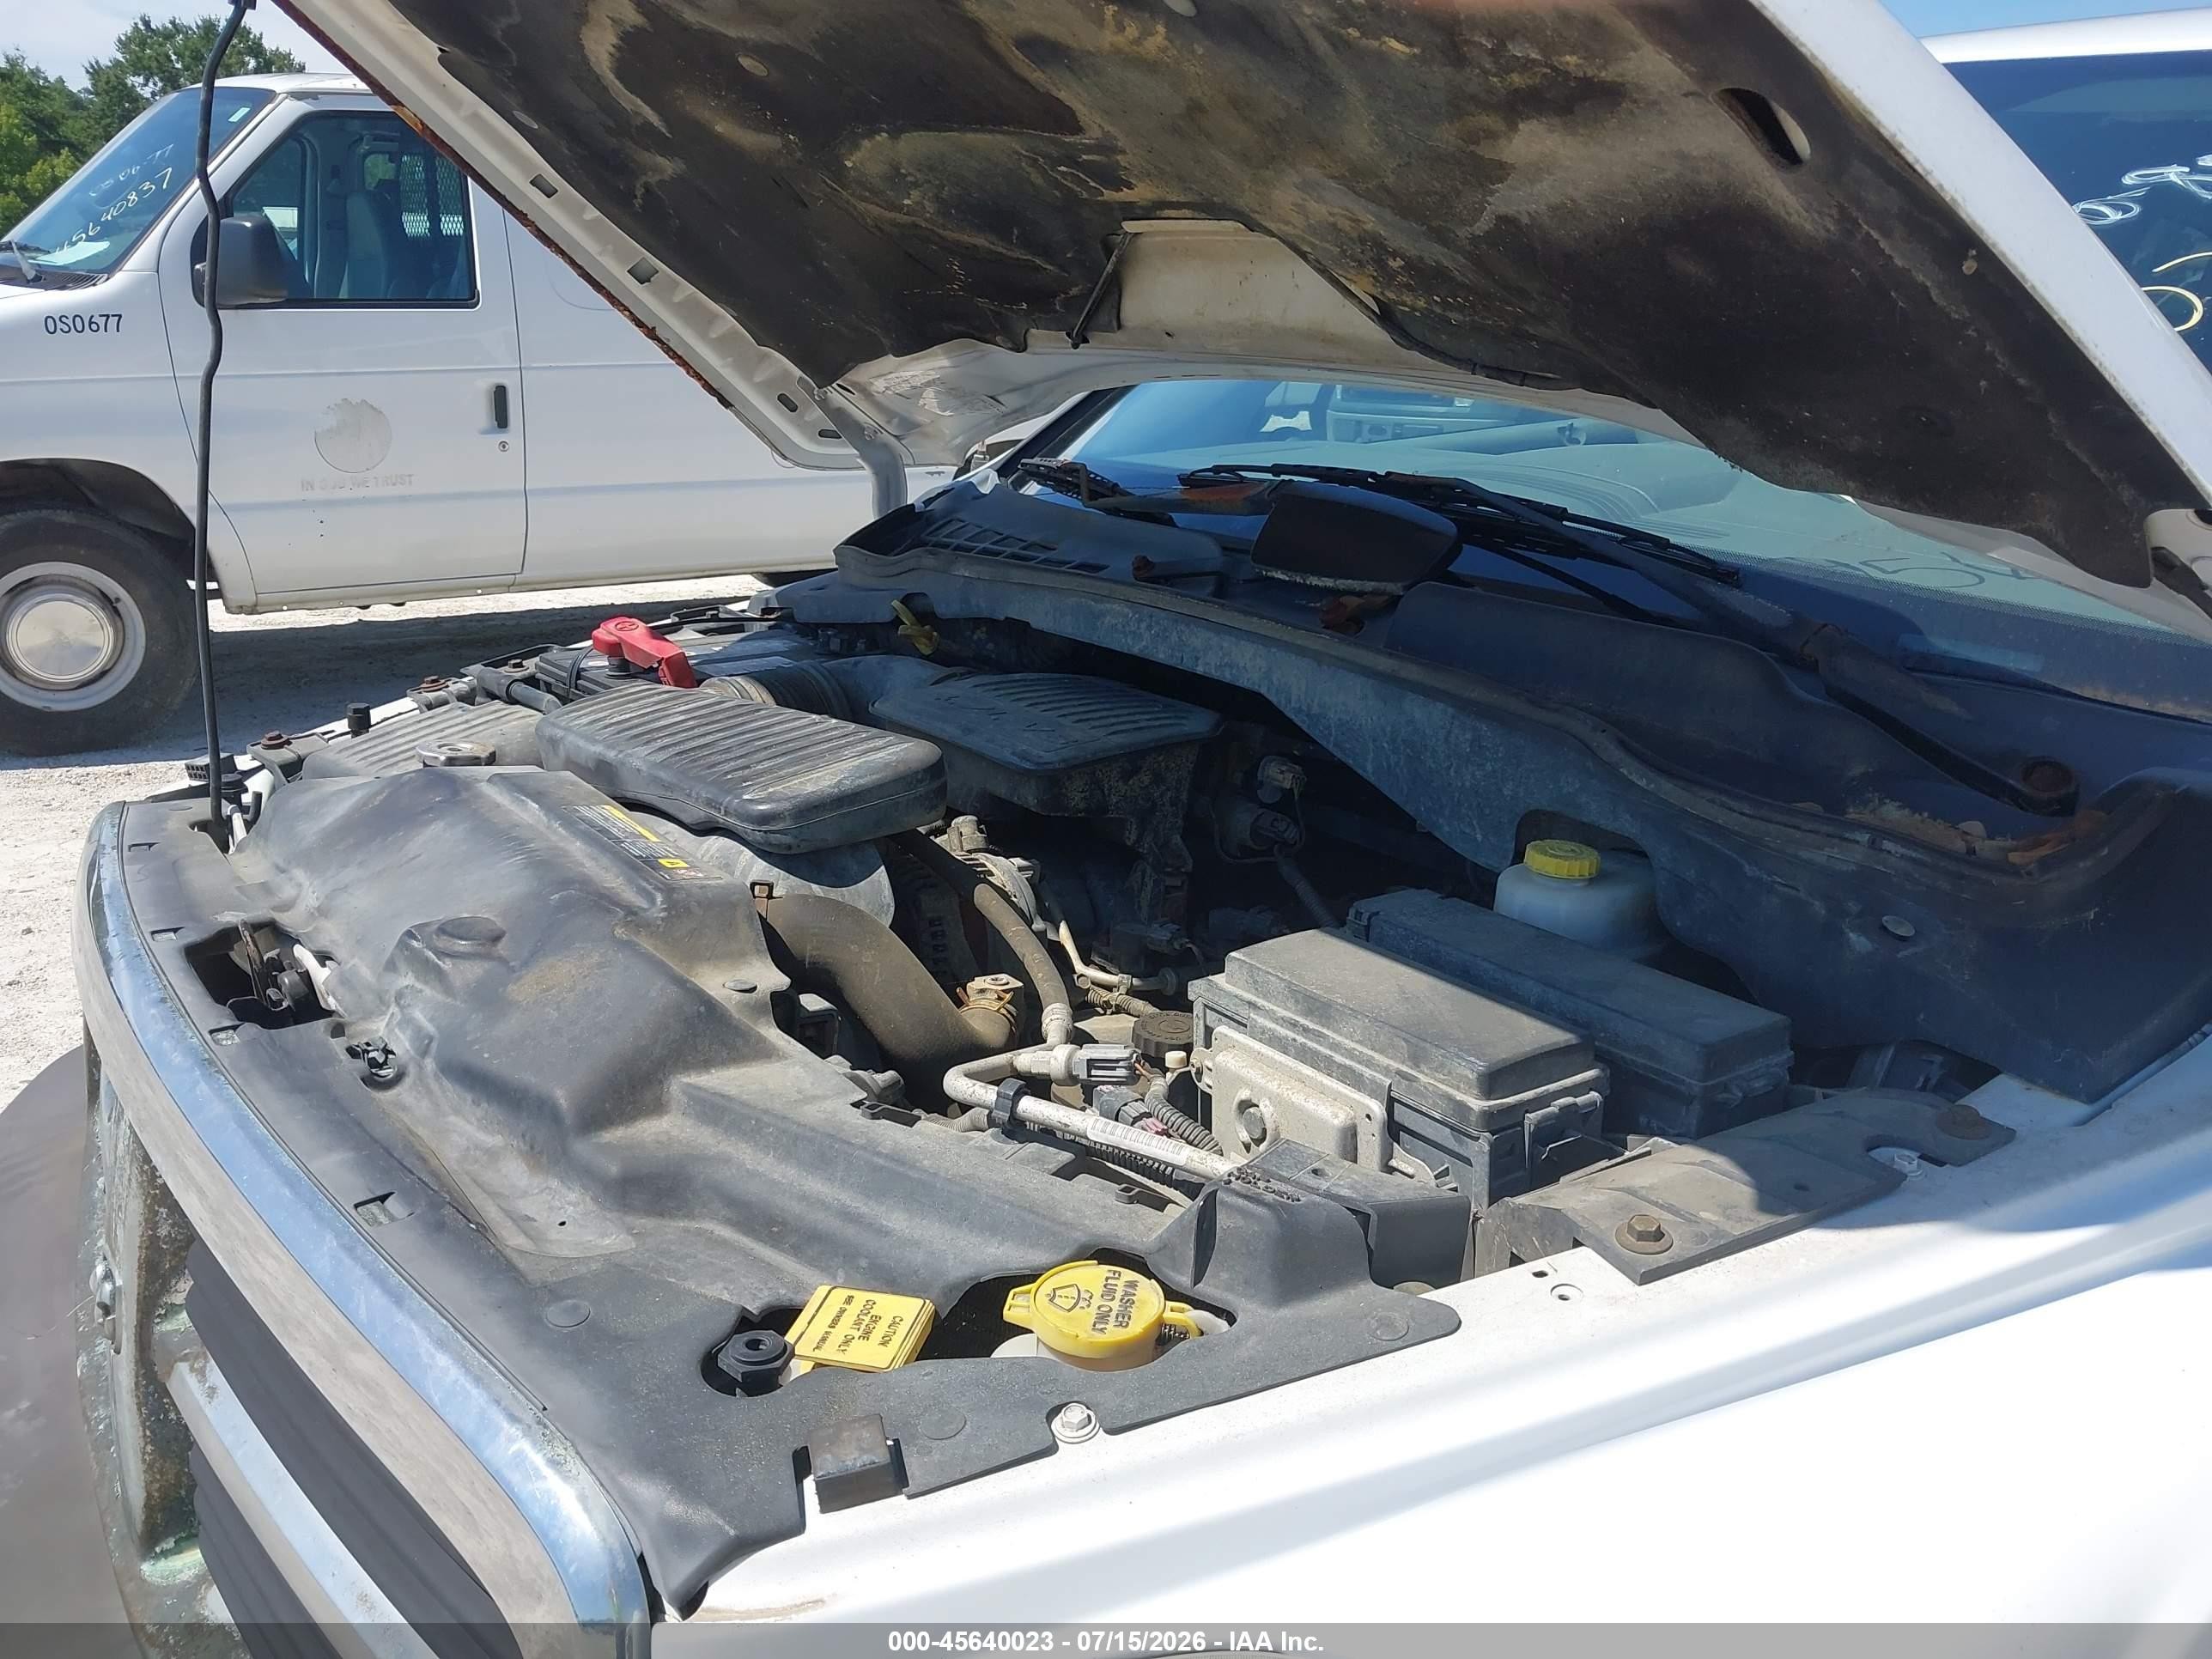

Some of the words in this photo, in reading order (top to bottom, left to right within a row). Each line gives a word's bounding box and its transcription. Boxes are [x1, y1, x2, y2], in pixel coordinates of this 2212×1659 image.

[1100, 1270, 1121, 1302] FLUID
[849, 1299, 877, 1332] COOLANT
[1091, 1304, 1113, 1335] ONLY
[1113, 1279, 1139, 1328] WASHER
[857, 1314, 882, 1341] ENGINE
[878, 1316, 904, 1348] CAUTION
[836, 1334, 855, 1355] ONLY
